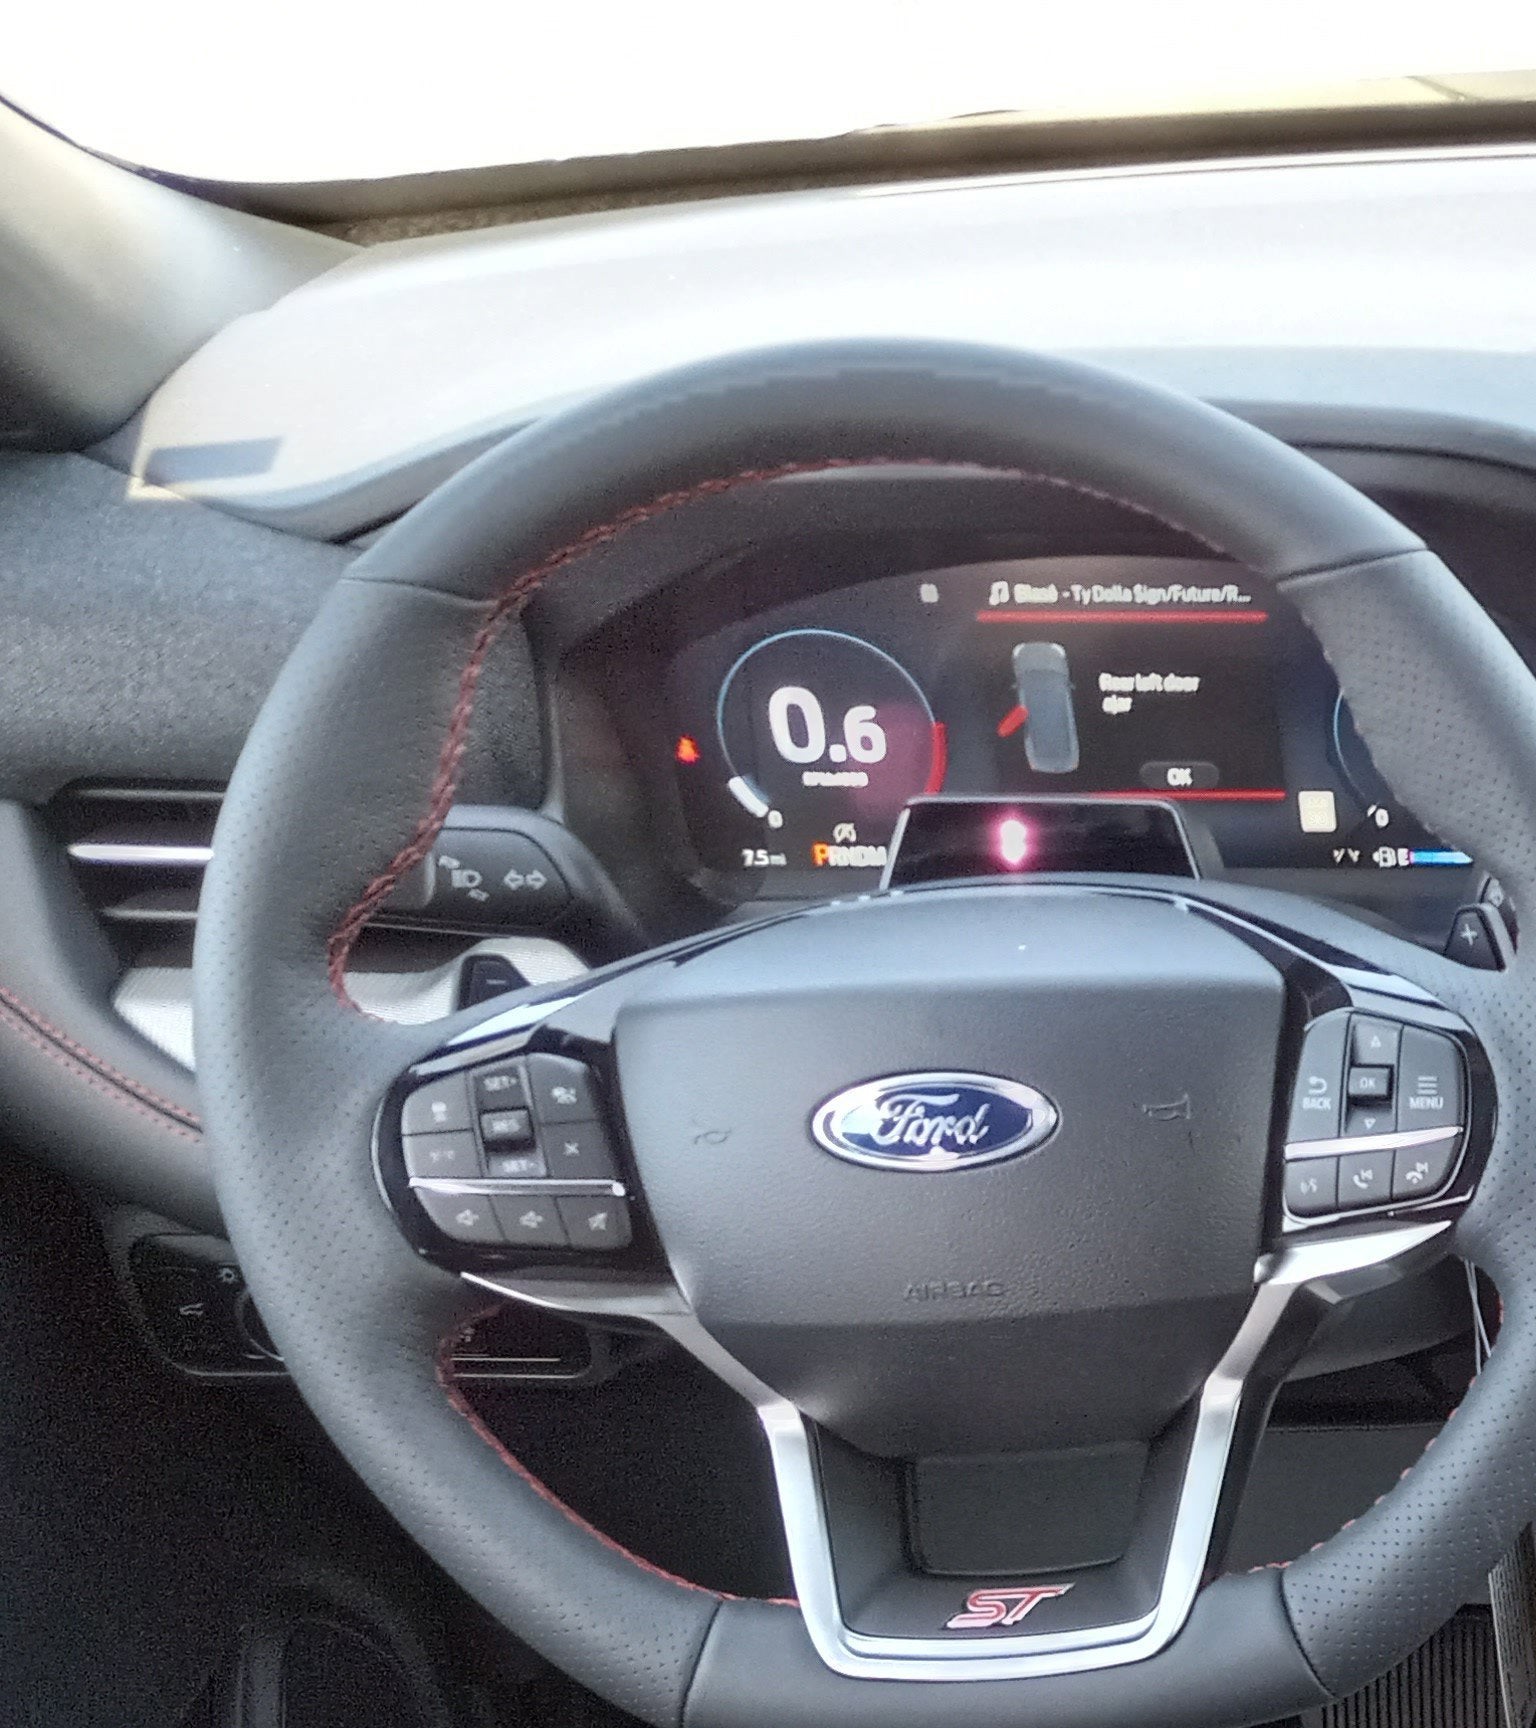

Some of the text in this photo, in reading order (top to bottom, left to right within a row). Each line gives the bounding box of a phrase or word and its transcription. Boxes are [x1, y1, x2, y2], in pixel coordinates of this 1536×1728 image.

[768, 686, 887, 764] 0.6
[1359, 1077, 1376, 1089] OK
[1302, 1096, 1332, 1111] BACK
[1409, 1096, 1444, 1111] MENU
[868, 1093, 991, 1147] Ford
[946, 1581, 1076, 1629] ST
